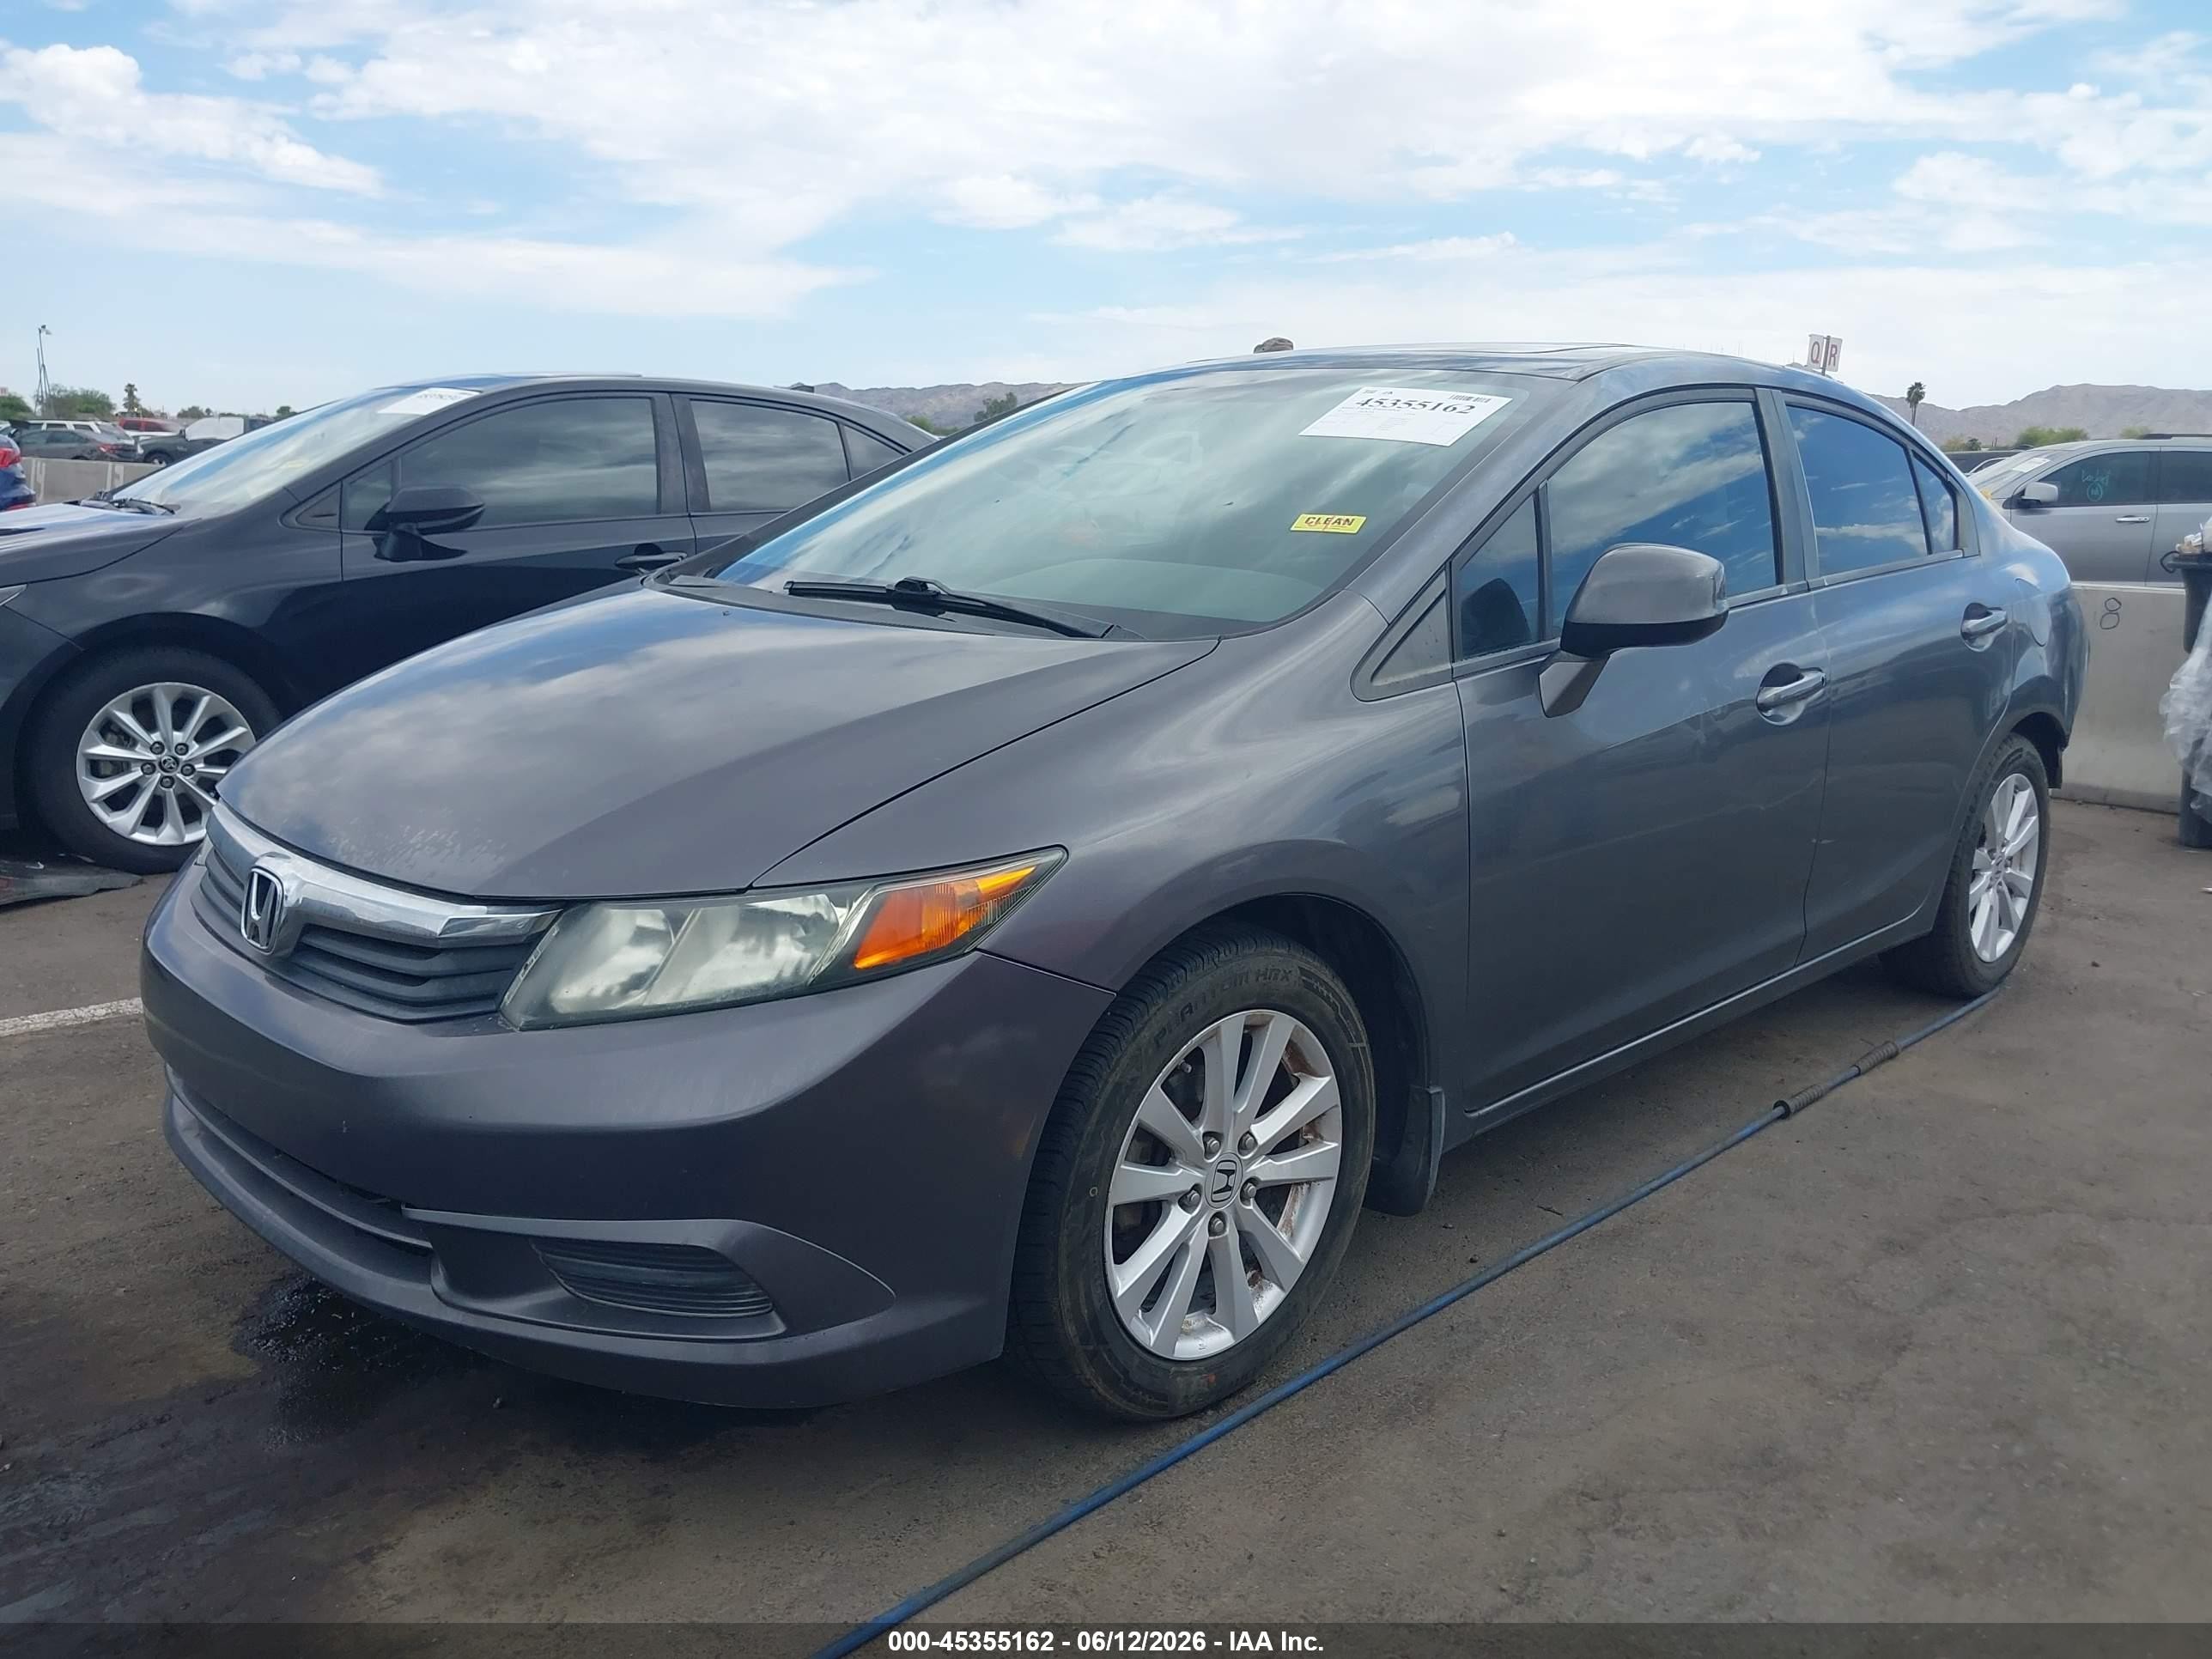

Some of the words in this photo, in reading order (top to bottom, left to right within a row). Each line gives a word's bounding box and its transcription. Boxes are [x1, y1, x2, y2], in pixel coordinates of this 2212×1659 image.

[1810, 341, 1820, 364] Q
[1827, 343, 1838, 367] R
[1355, 397, 1476, 415] 45355162
[1305, 516, 1355, 526] CLEAN
[2100, 597, 2122, 630] 8
